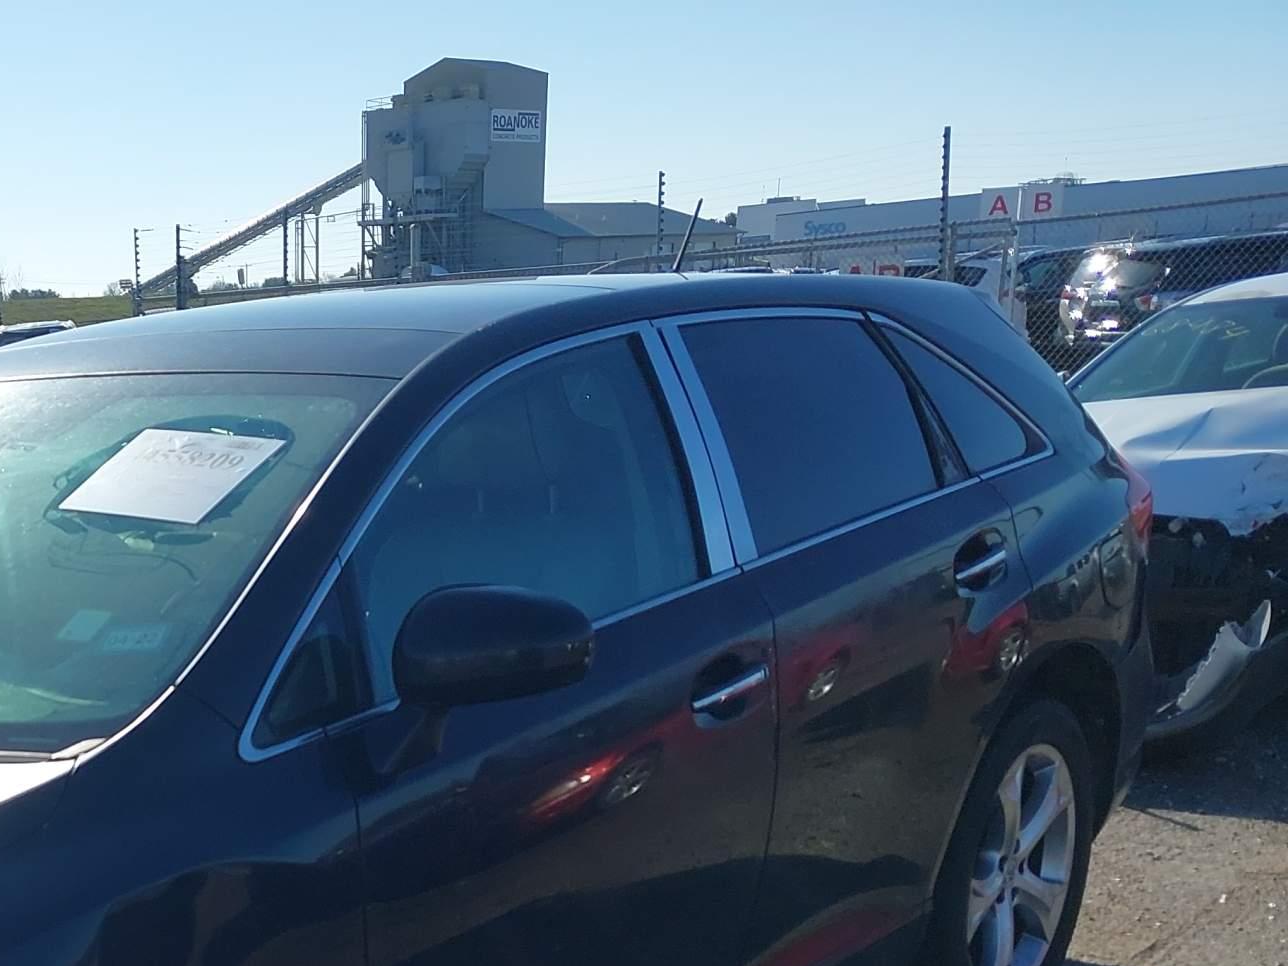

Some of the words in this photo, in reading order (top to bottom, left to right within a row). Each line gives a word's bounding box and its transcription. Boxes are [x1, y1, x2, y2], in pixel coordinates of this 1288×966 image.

[492, 113, 540, 130] ROANOKE
[988, 194, 1009, 216] A
[1033, 191, 1053, 213] B
[804, 220, 847, 236] Sysco
